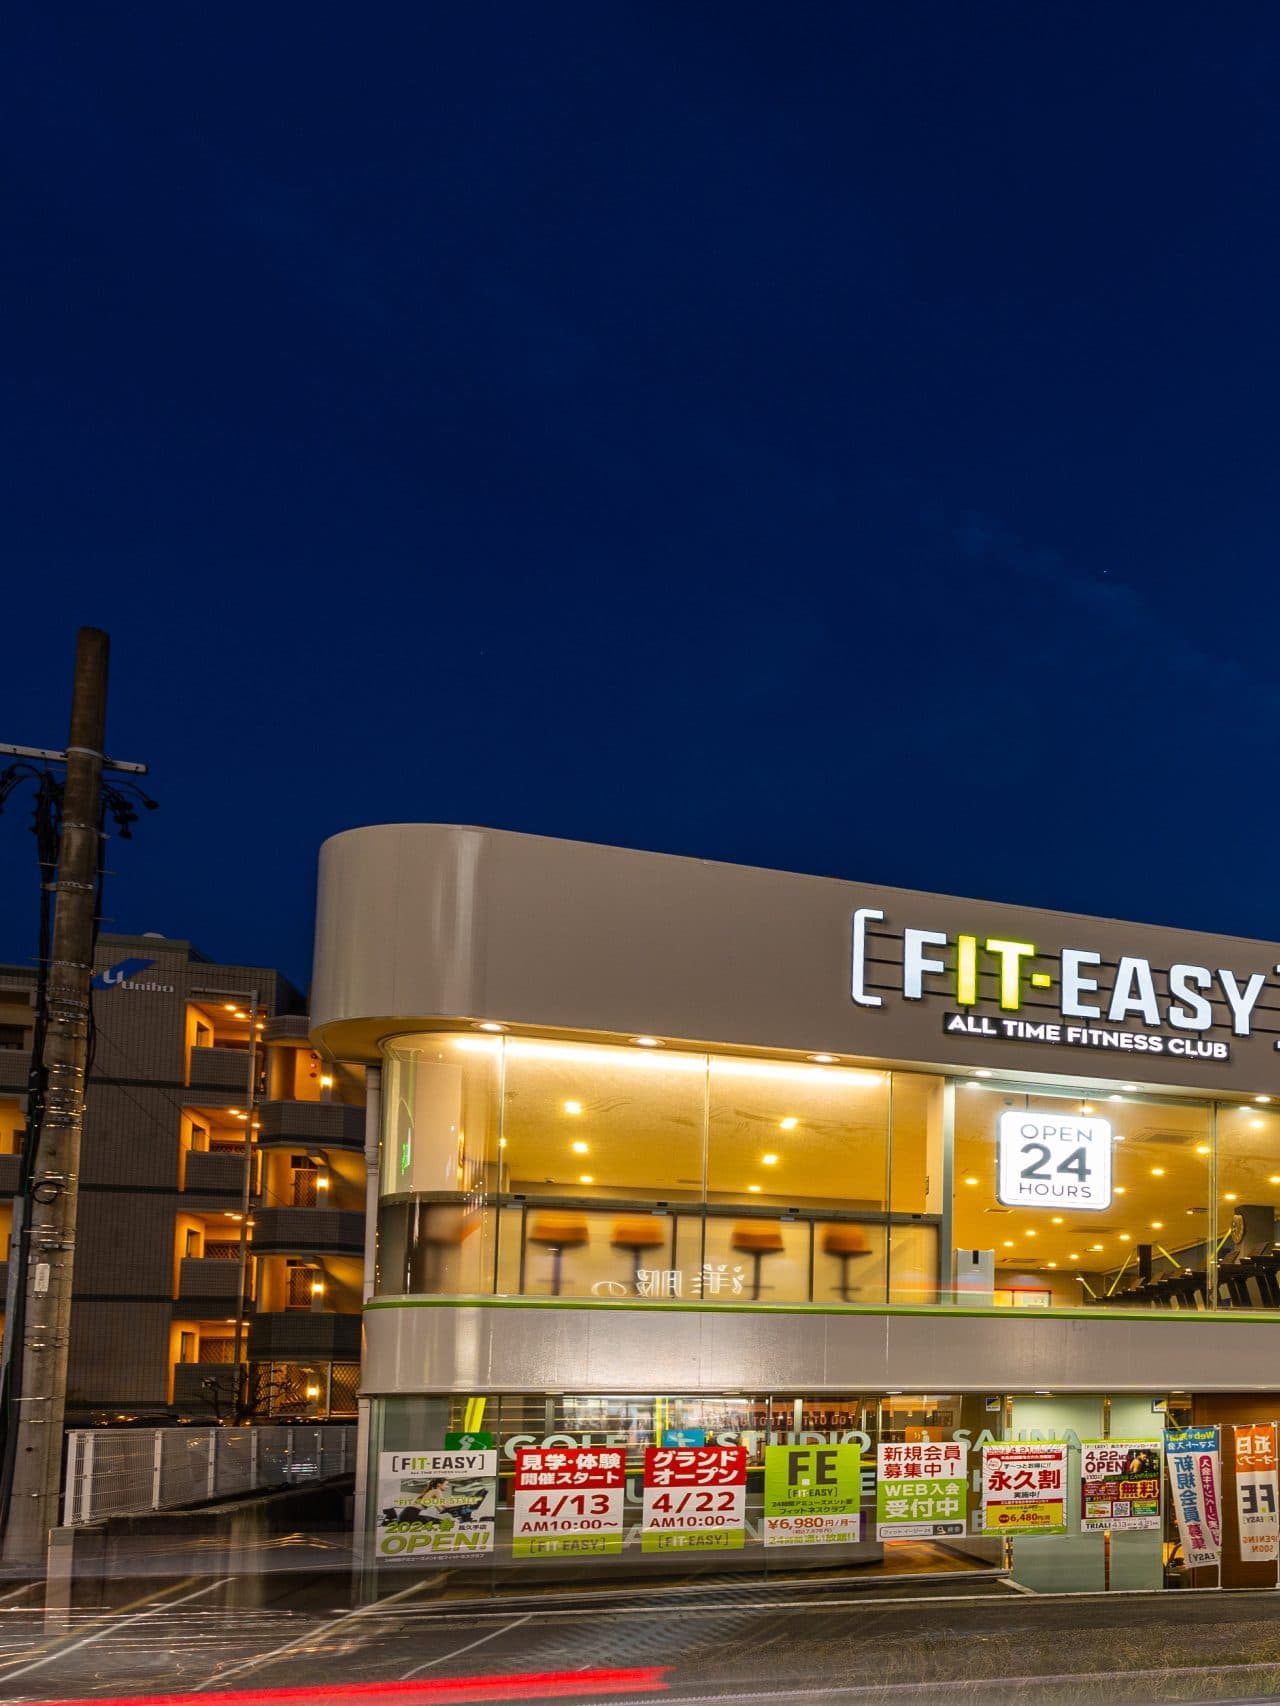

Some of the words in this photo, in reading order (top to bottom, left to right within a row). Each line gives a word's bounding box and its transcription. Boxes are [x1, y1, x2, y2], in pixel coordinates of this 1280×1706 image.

[947, 1015, 997, 1036] ALL
[1003, 1020, 1060, 1042] TIME
[1067, 1026, 1163, 1053] FITNESS
[1168, 1037, 1228, 1059] CLUB
[1020, 1123, 1093, 1142] OPEN
[1020, 1144, 1092, 1183] 24
[1019, 1183, 1092, 1199] HOURS
[653, 1450, 739, 1468] グランド
[884, 1446, 961, 1461] 新規会員
[653, 1467, 739, 1485] オープン
[988, 1469, 1060, 1491] 永久割
[1120, 1480, 1159, 1499] 無料
[528, 1494, 609, 1517] 4/13
[652, 1492, 735, 1513] 4/22
[885, 1497, 959, 1518] 受付中
[381, 1532, 490, 1554] OPEN!
